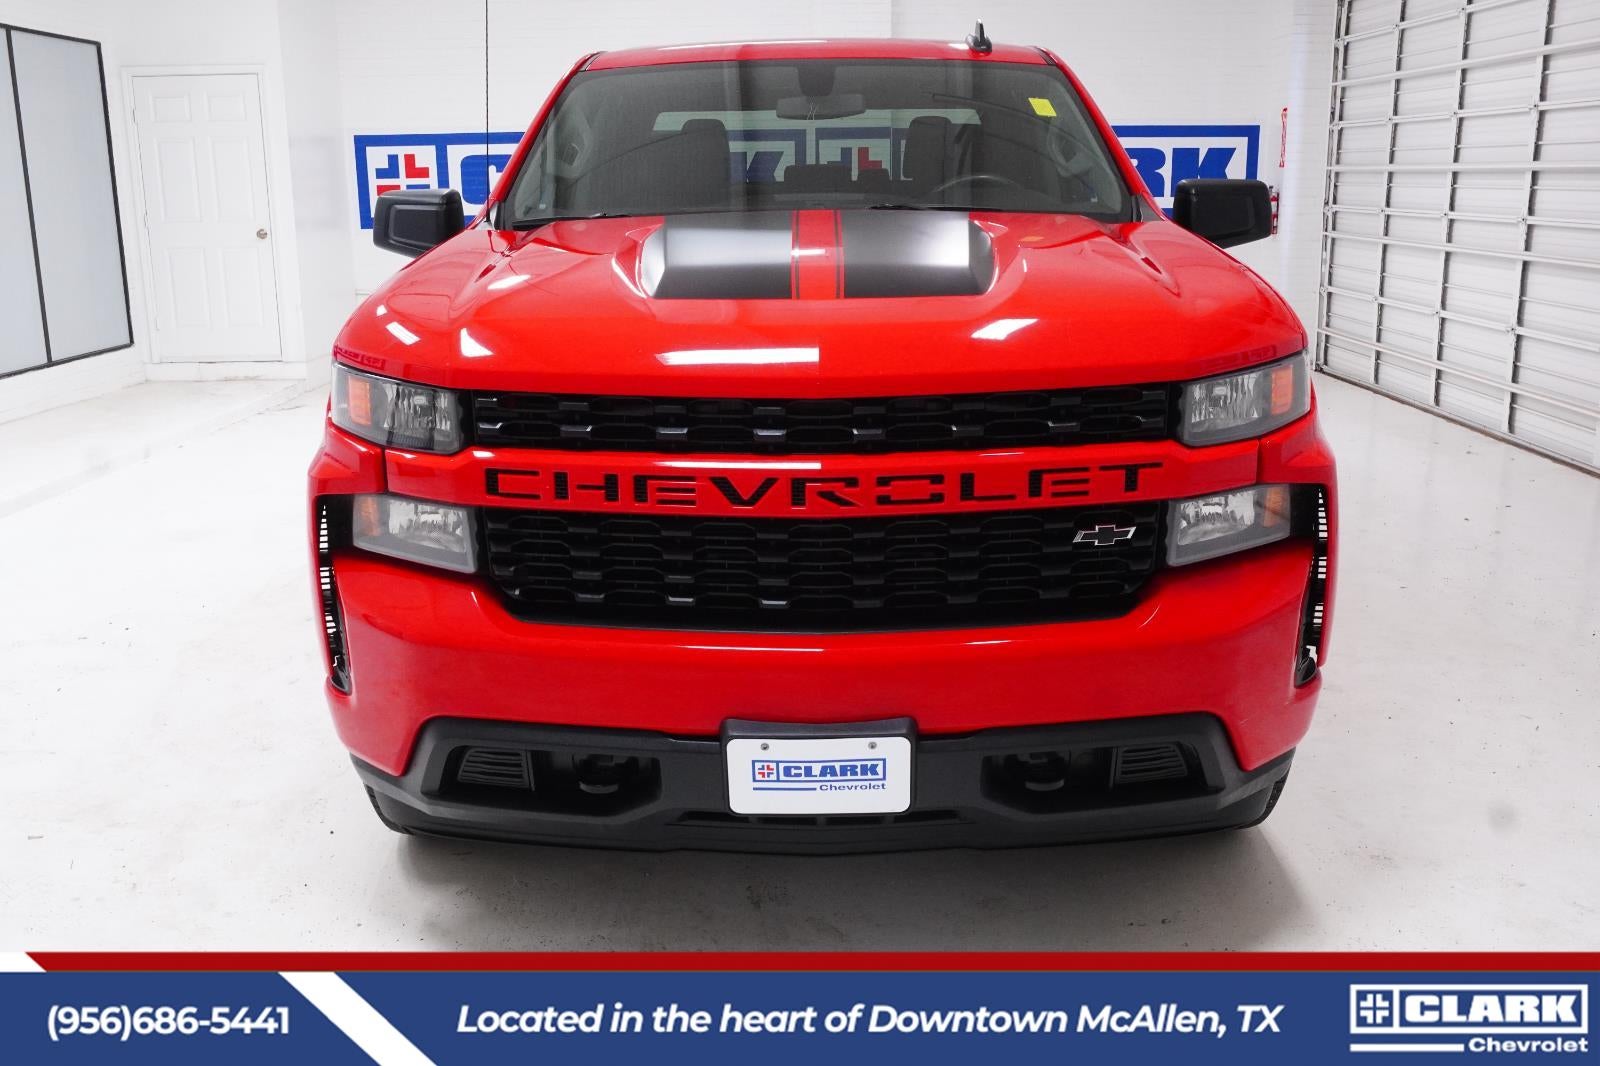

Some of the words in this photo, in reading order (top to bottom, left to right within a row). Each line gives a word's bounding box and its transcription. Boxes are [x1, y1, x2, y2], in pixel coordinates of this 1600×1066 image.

[485, 461, 1163, 508] CHEVROLET
[782, 763, 880, 778] CLARK
[819, 782, 887, 792] Chevrolet
